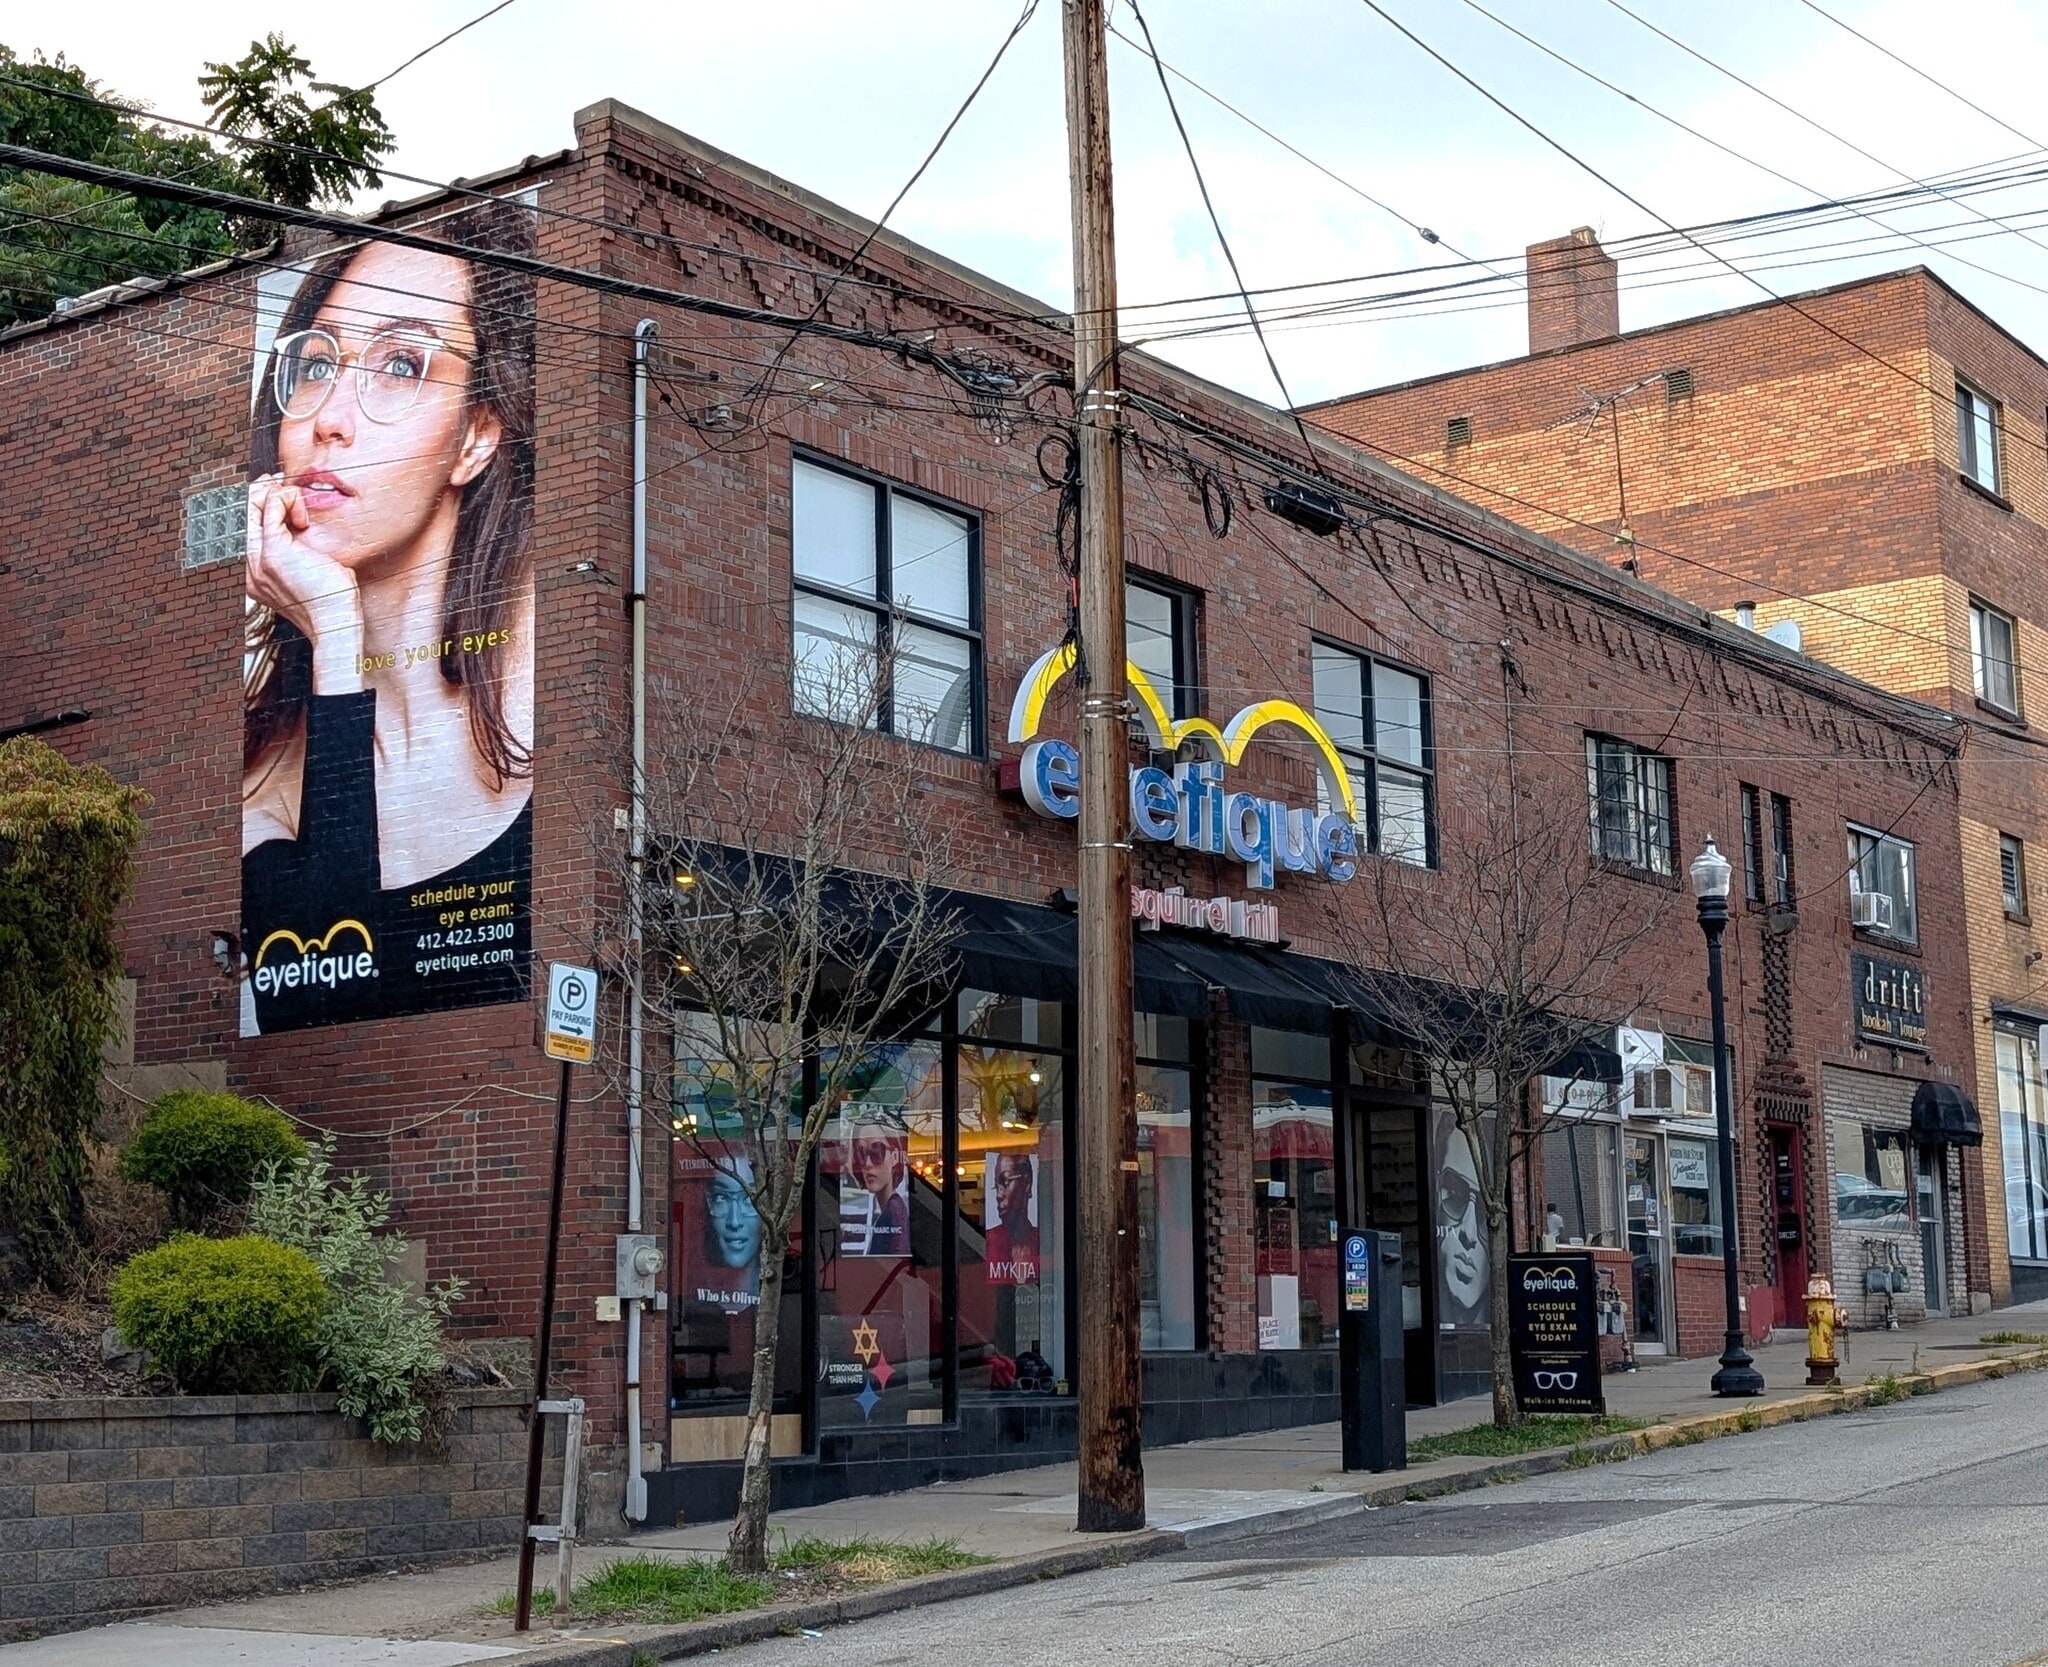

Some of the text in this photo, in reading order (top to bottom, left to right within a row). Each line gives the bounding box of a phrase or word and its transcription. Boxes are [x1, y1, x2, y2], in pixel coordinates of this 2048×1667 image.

[356, 628, 517, 675] love your eyes.
[1020, 738, 1357, 891] eetique
[411, 880, 515, 907] schedule your
[439, 902, 514, 928] eye exam:
[1131, 884, 1280, 943] squirrel hill
[416, 922, 514, 950] 412.422.5300
[415, 948, 514, 977] eyetique.com
[566, 981, 582, 1004] P
[1865, 961, 1921, 1014] drift
[551, 1009, 592, 1027] PAY PARKING
[1861, 1006, 1927, 1046] hookah lounge
[890, 1226, 903, 1234] NYC
[989, 1261, 1036, 1279] MYKITA
[697, 1287, 719, 1302] Who
[720, 1290, 731, 1303] Is
[1527, 1302, 1577, 1311] SCHEDULE
[1539, 1312, 1565, 1321] YOUR
[1528, 1323, 1577, 1331] EYE EXAM
[1534, 1333, 1571, 1342] TODAY!
[829, 1363, 863, 1373] STRONGER
[829, 1374, 863, 1385] THAN HATE
